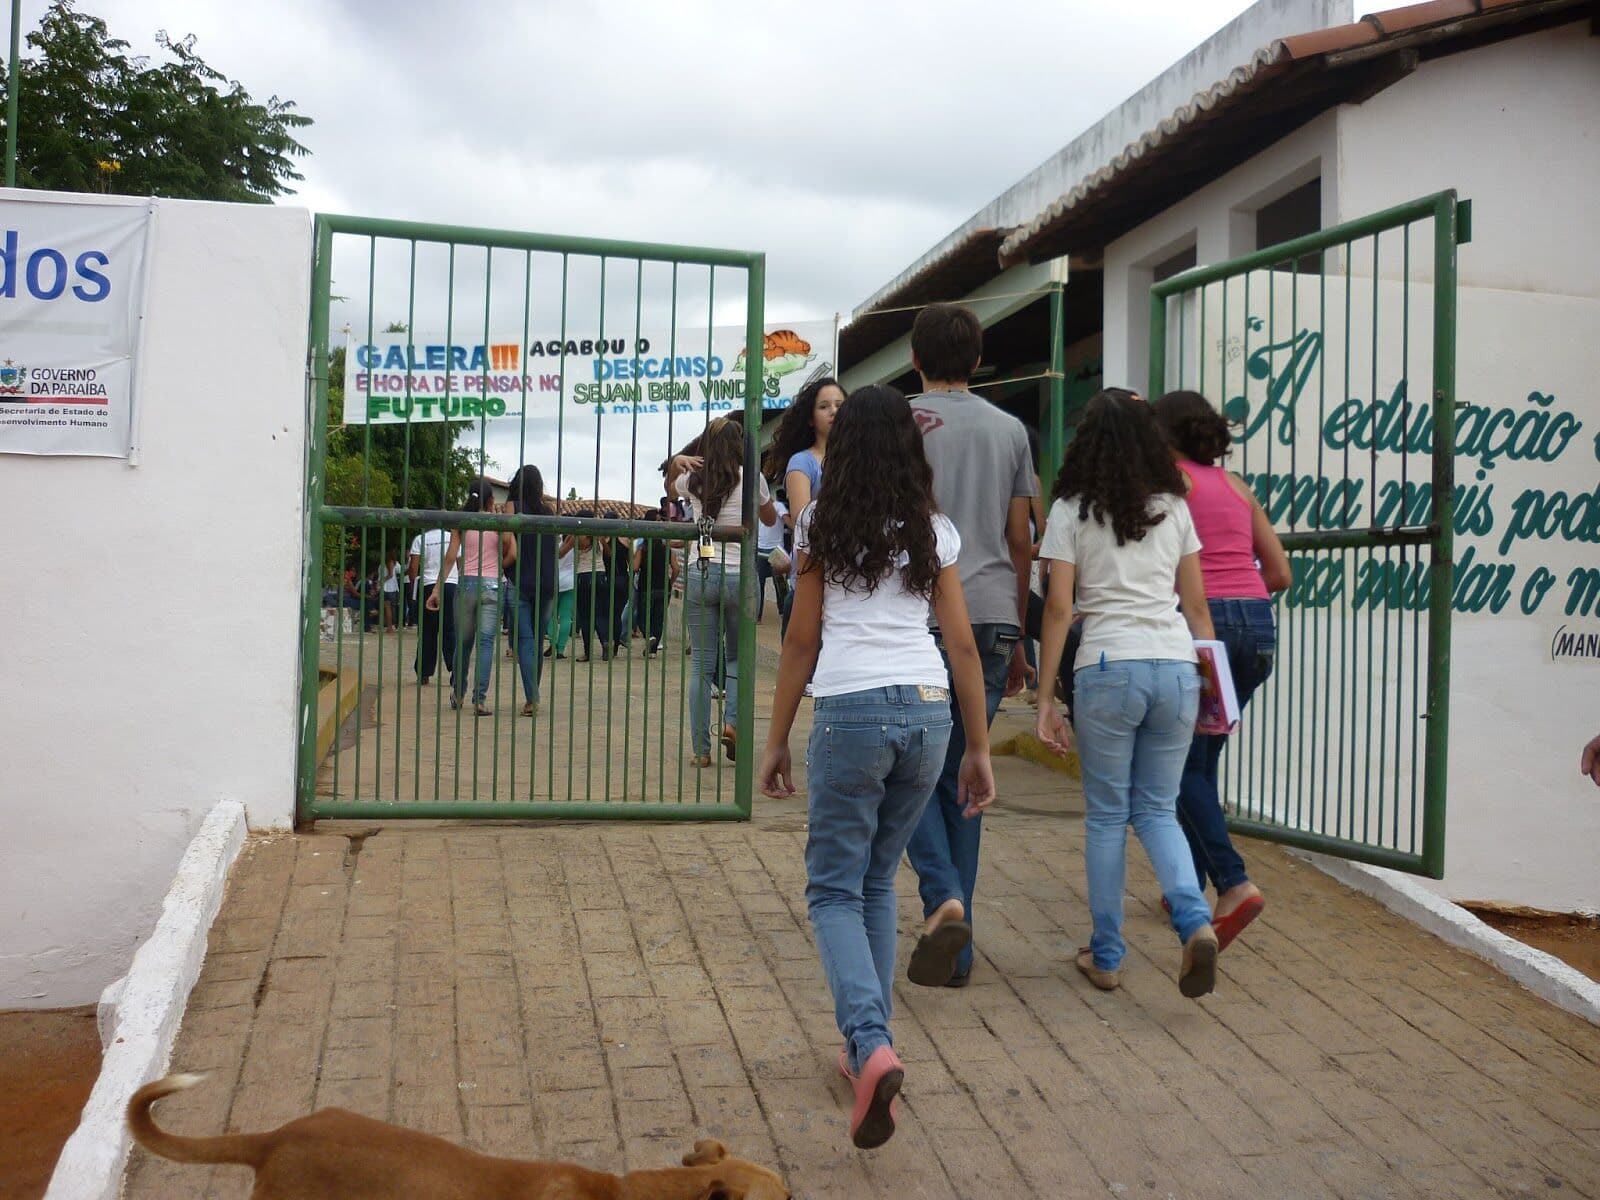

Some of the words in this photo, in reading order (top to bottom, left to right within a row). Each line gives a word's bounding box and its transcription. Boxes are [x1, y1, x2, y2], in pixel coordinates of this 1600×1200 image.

[530, 340, 625, 357] ACABOU
[635, 338, 650, 354] O
[31, 368, 96, 381] GOVERNO
[593, 357, 724, 380] DESCANSO
[31, 382, 50, 395] DA
[52, 382, 107, 396] PARAÍBA
[374, 373, 430, 392] HORA
[434, 375, 458, 393] DE
[463, 375, 533, 393] PENSAR
[540, 374, 562, 392] NO
[648, 382, 690, 401] BEM
[699, 377, 781, 400] VINDS
[62, 408, 94, 416] Estado
[96, 408, 108, 416] do
[0, 418, 67, 426] senvolvimento
[70, 419, 108, 427] Humano
[1374, 469, 1494, 536] mis
[1520, 566, 1556, 615] o
